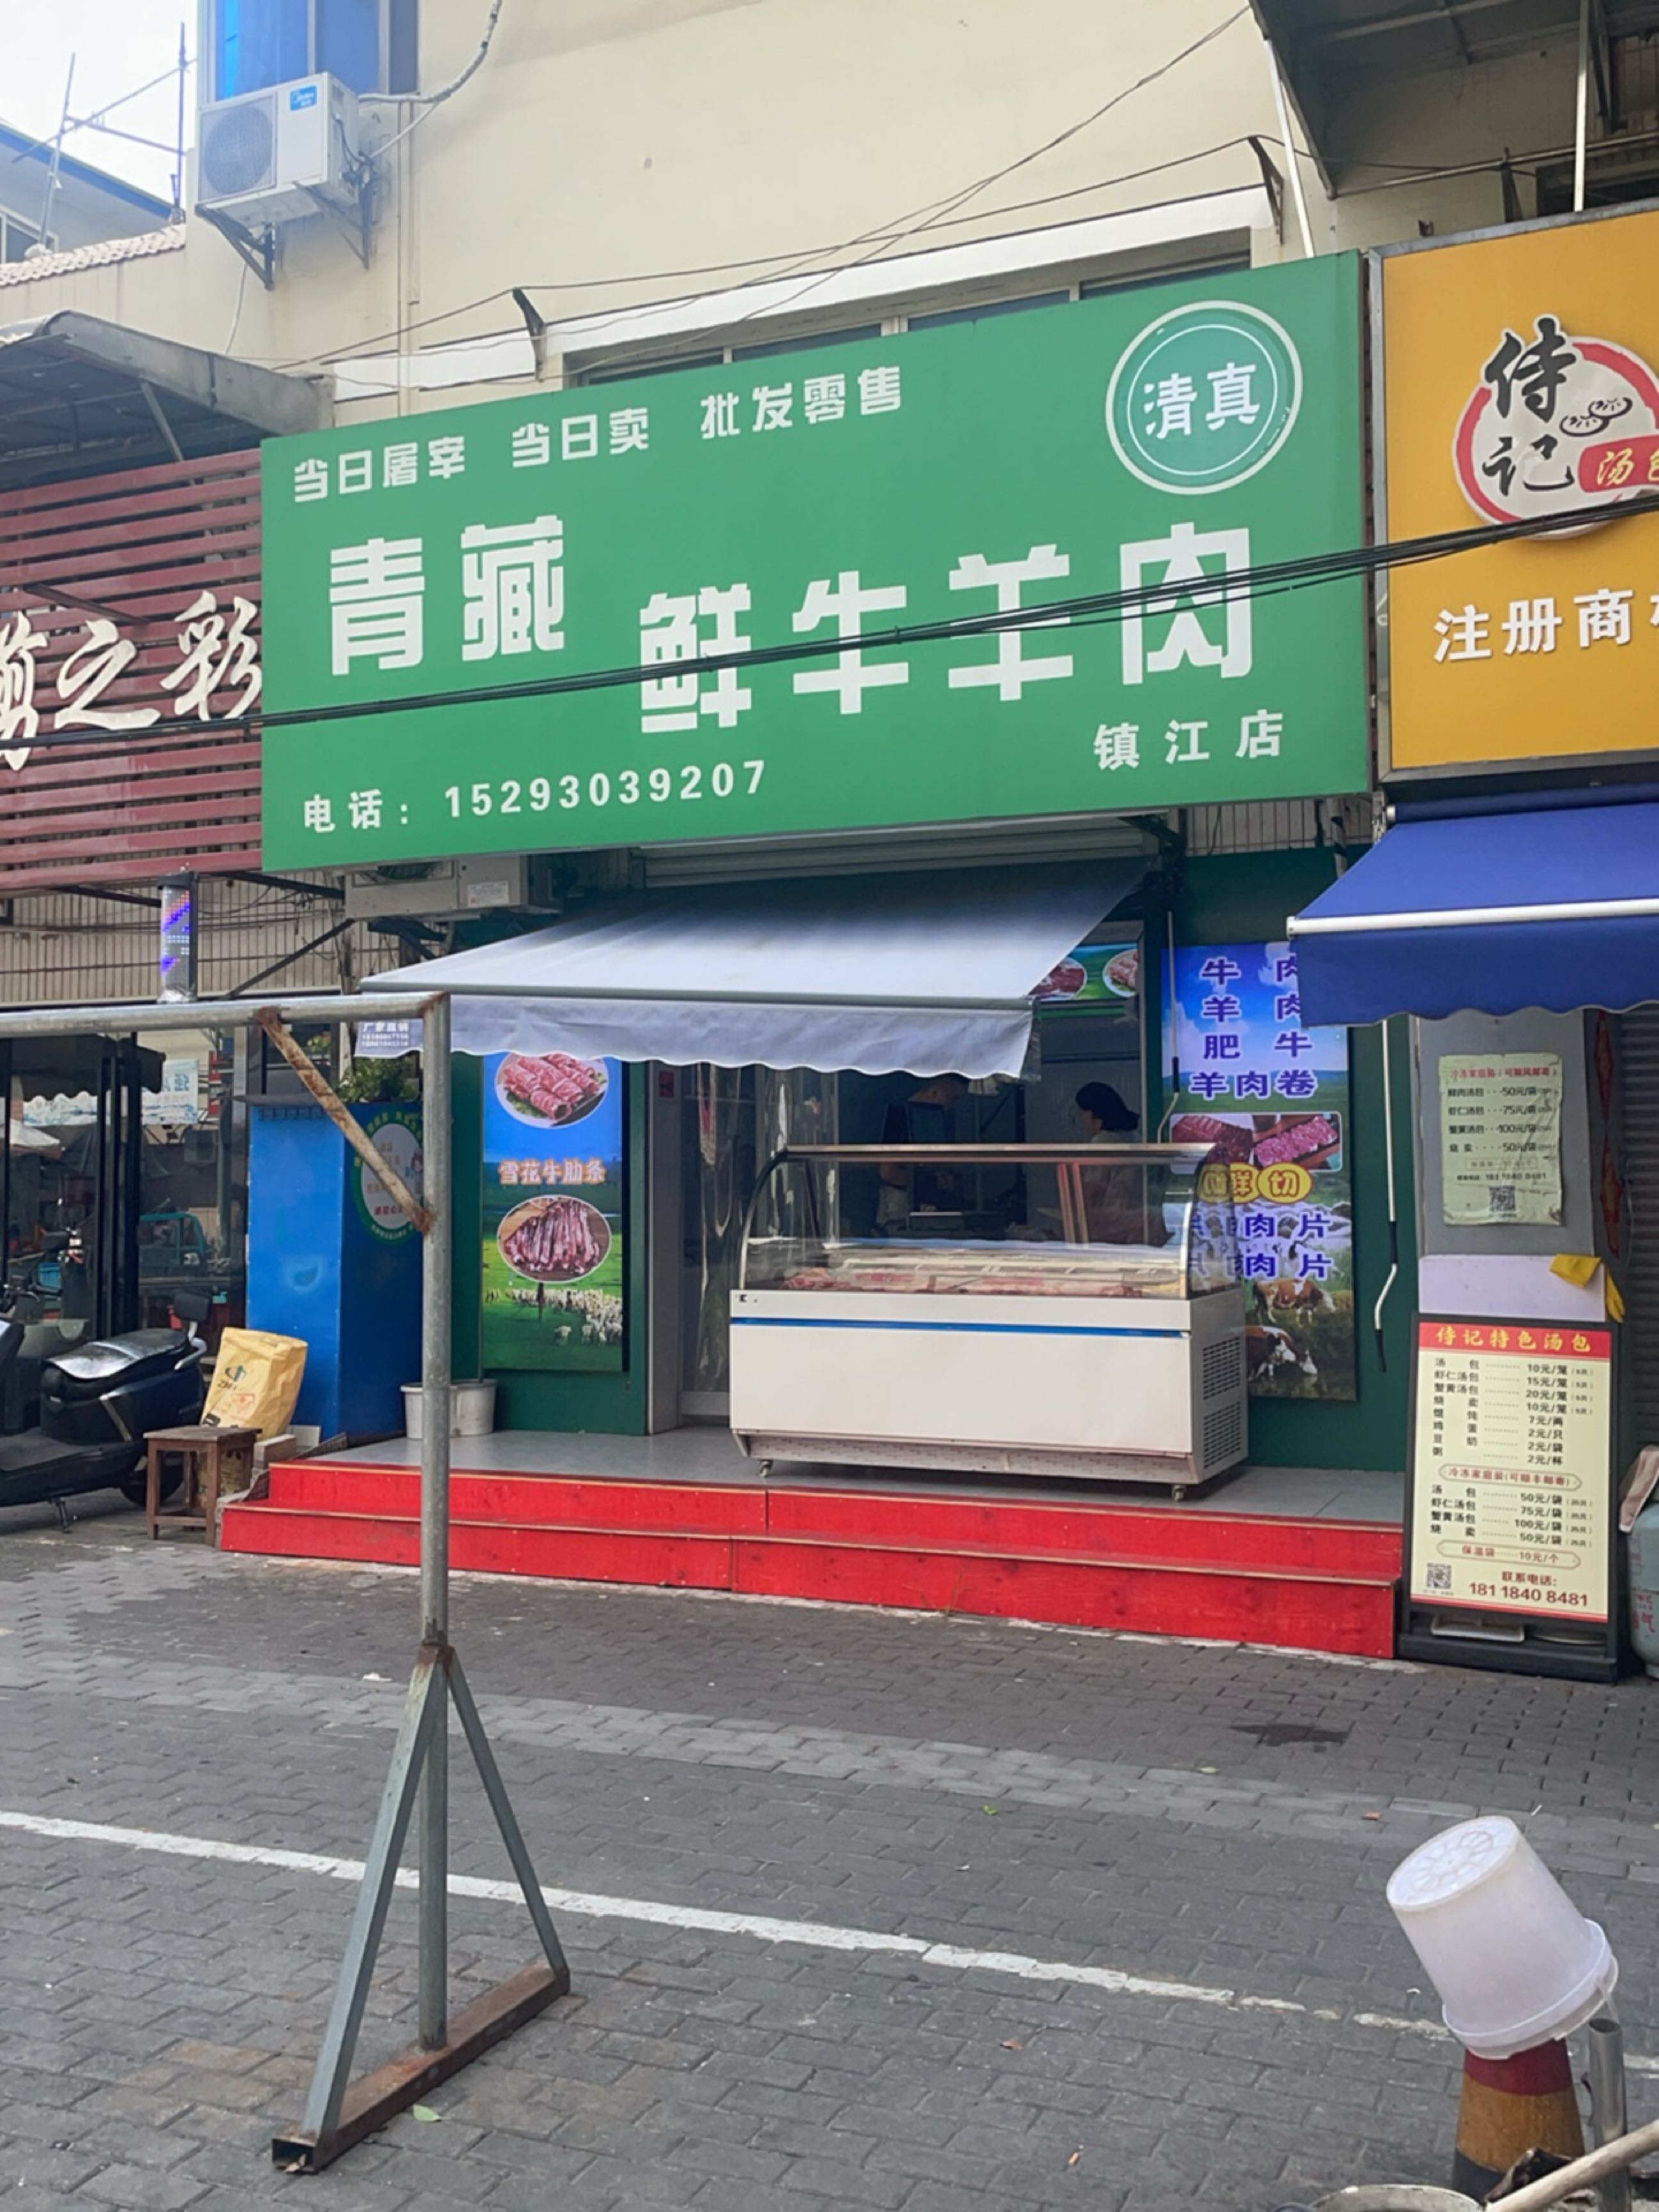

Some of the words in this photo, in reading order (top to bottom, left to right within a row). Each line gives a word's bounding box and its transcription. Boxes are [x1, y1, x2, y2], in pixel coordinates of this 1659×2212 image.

[1144, 362, 1260, 439] 清真
[294, 436, 465, 502] 当日屠宰
[512, 407, 648, 468] 当日卖
[701, 366, 901, 439] 批发零售
[330, 515, 564, 676] 青藏
[640, 522, 1252, 733] 鲜牛羊肉
[1434, 589, 1659, 664] 注册商
[1094, 709, 1283, 770] 镇江店
[445, 760, 765, 817] 15293039207
[1203, 1032, 1312, 1059] 肥牛
[1190, 1070, 1315, 1098] 羊肉卷
[499, 1157, 607, 1185] 雪花牛肋条
[1437, 1326, 1591, 1352] 侍记特色汤包
[1519, 1551, 1559, 1563] 10元/个
[1469, 1582, 1495, 1596] 181
[1501, 1585, 1541, 1601] 1840
[1546, 1590, 1587, 1607] 8481
